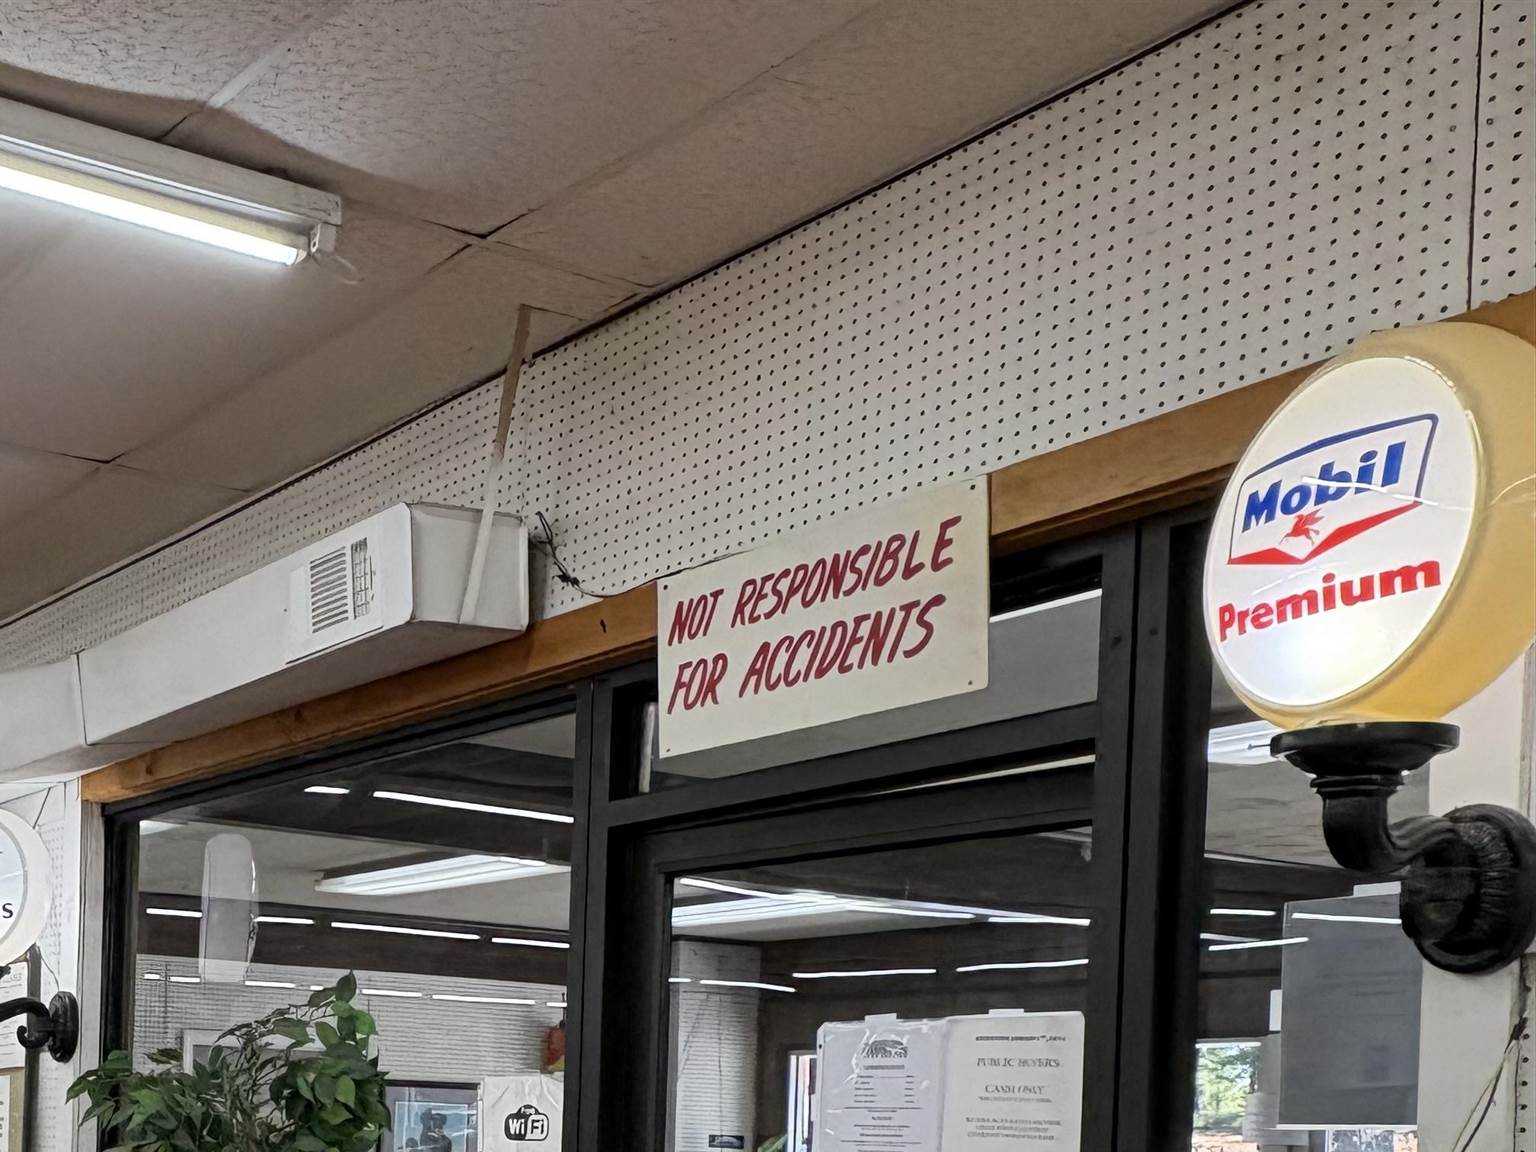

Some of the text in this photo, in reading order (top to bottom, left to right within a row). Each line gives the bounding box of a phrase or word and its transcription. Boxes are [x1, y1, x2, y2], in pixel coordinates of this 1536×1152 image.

[1241, 440, 1408, 534] Mobil
[666, 514, 963, 647] NOT RESPONSIBLE
[1218, 559, 1442, 642] Premium
[666, 594, 947, 715] FOR ACCIDENTS
